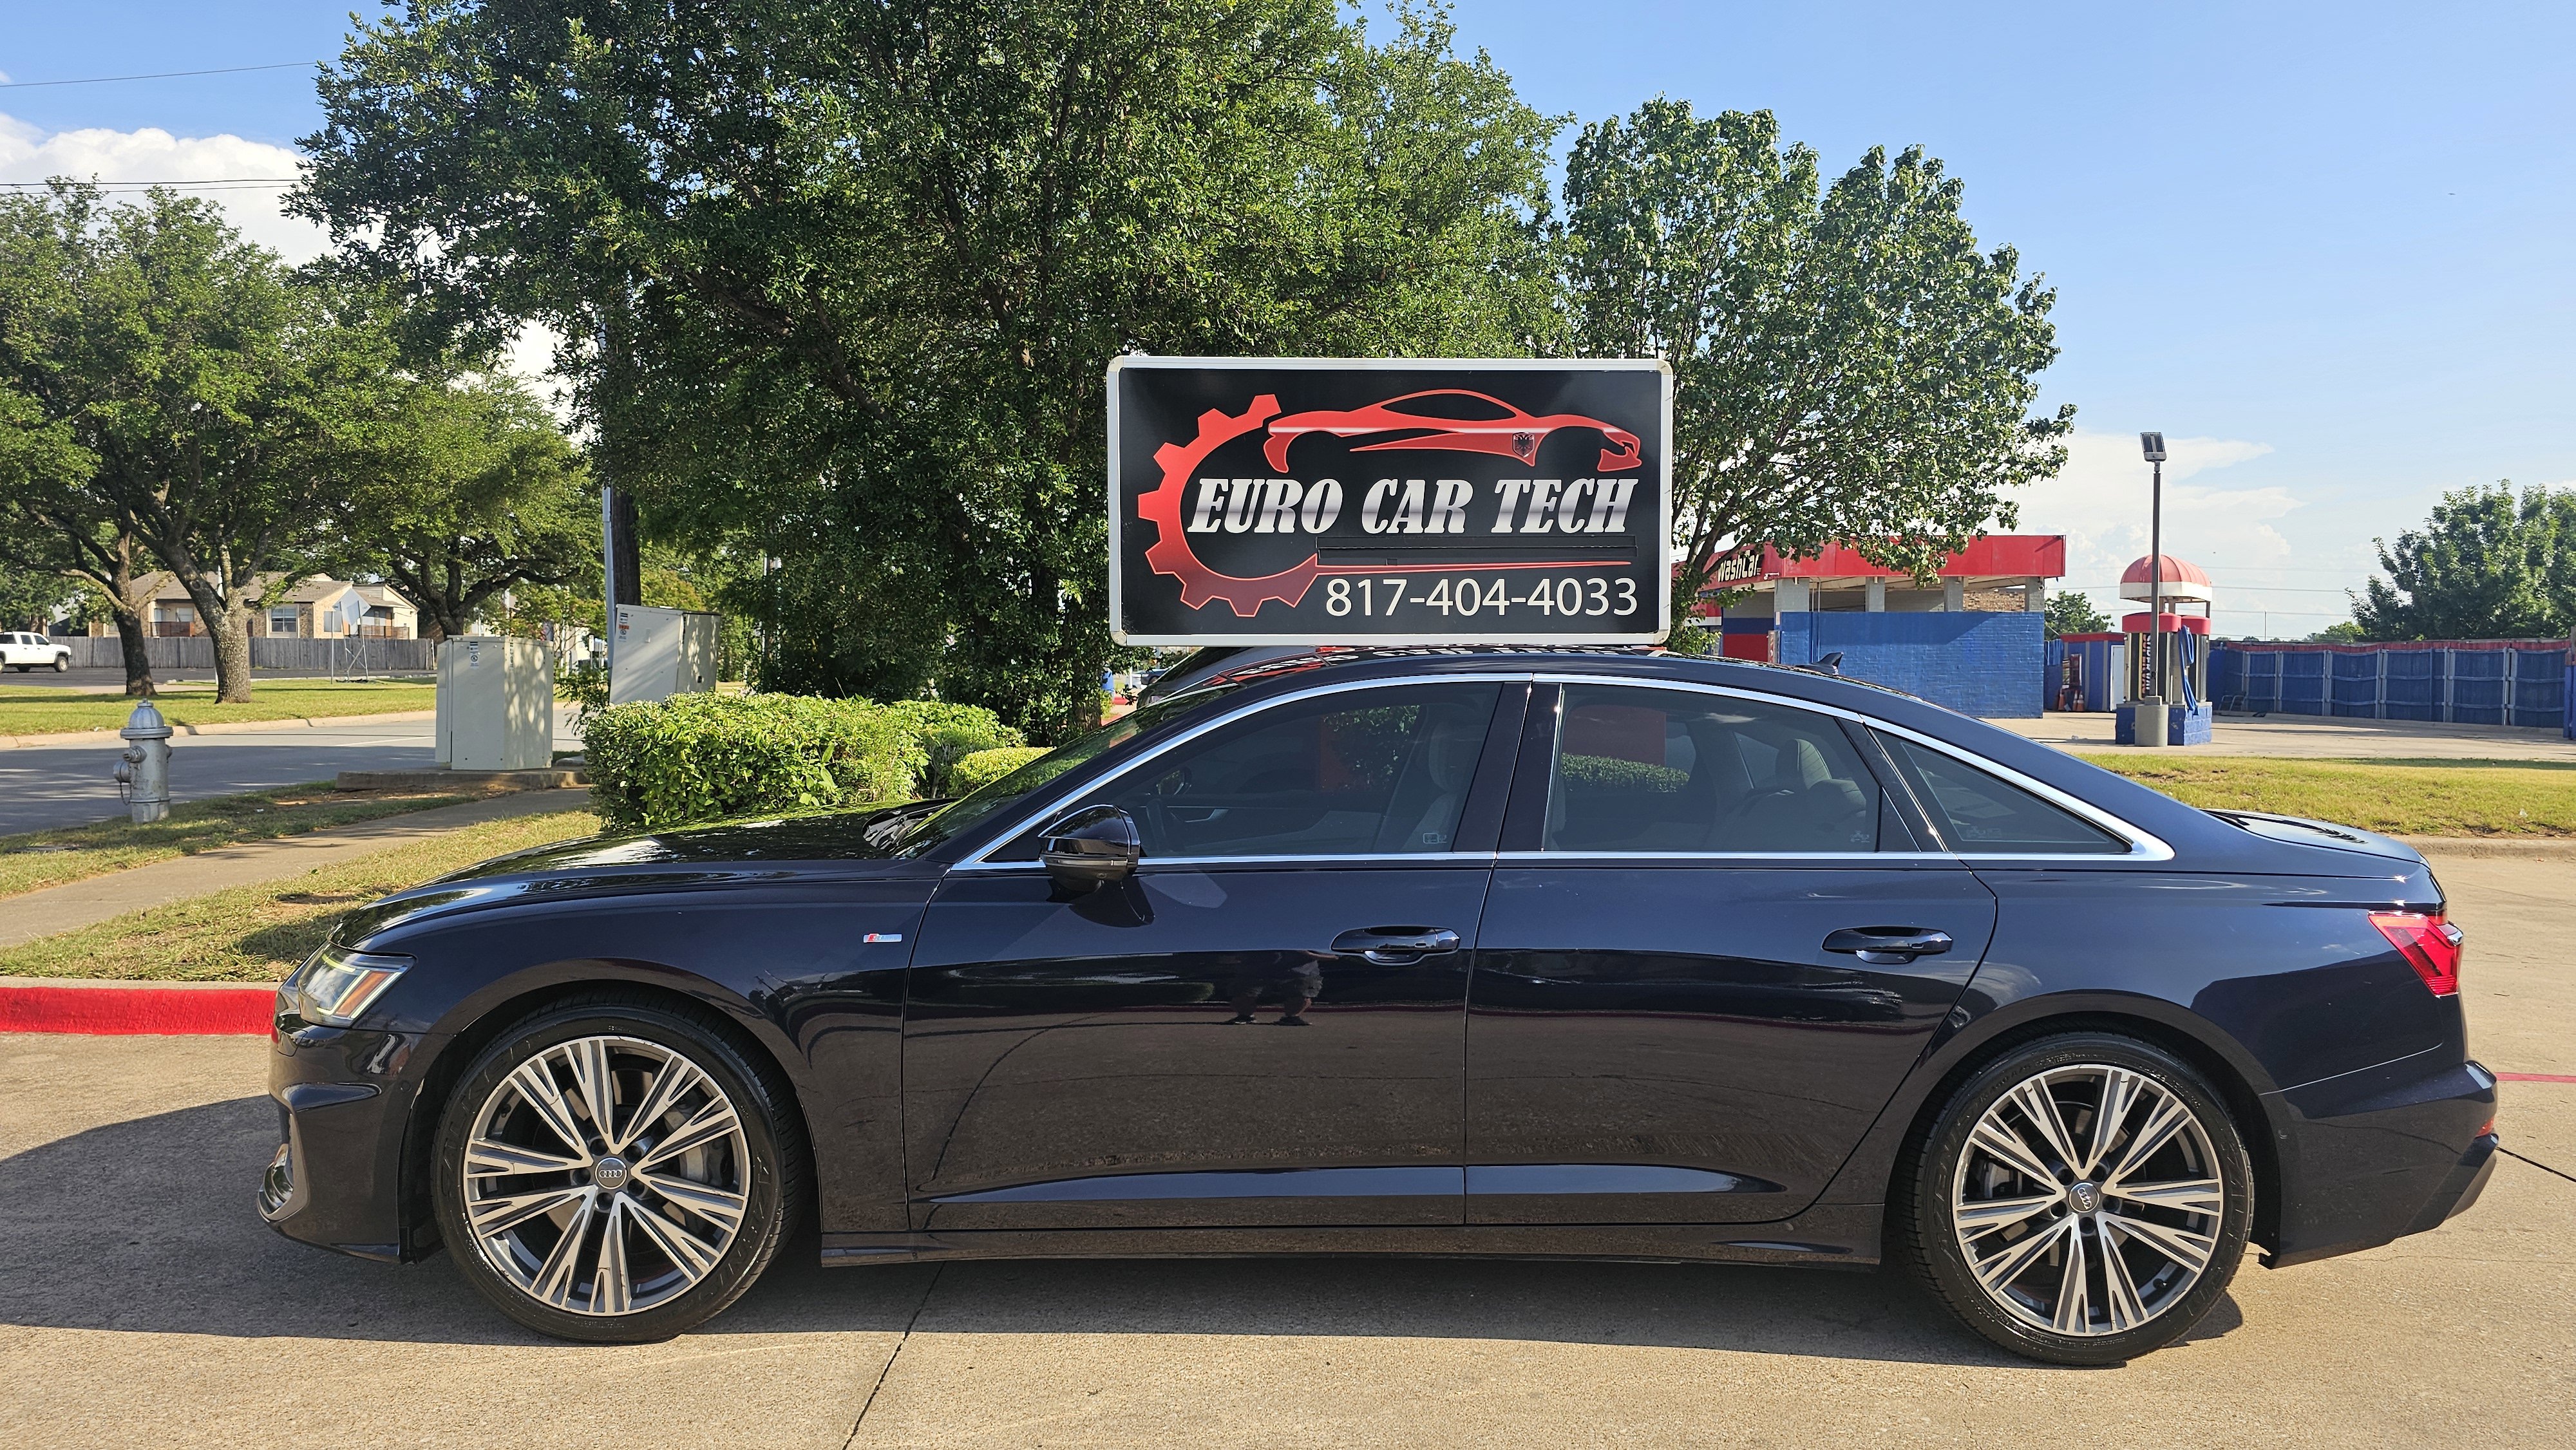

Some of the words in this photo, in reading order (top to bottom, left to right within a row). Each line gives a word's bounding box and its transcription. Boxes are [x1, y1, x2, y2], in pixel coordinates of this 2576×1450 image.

[1188, 478, 1344, 534] EURO
[1361, 478, 1474, 534] CAR
[1490, 478, 1638, 534] TECH
[1718, 550, 1759, 583] WashCar
[1325, 578, 1638, 617] 817-404-4033
